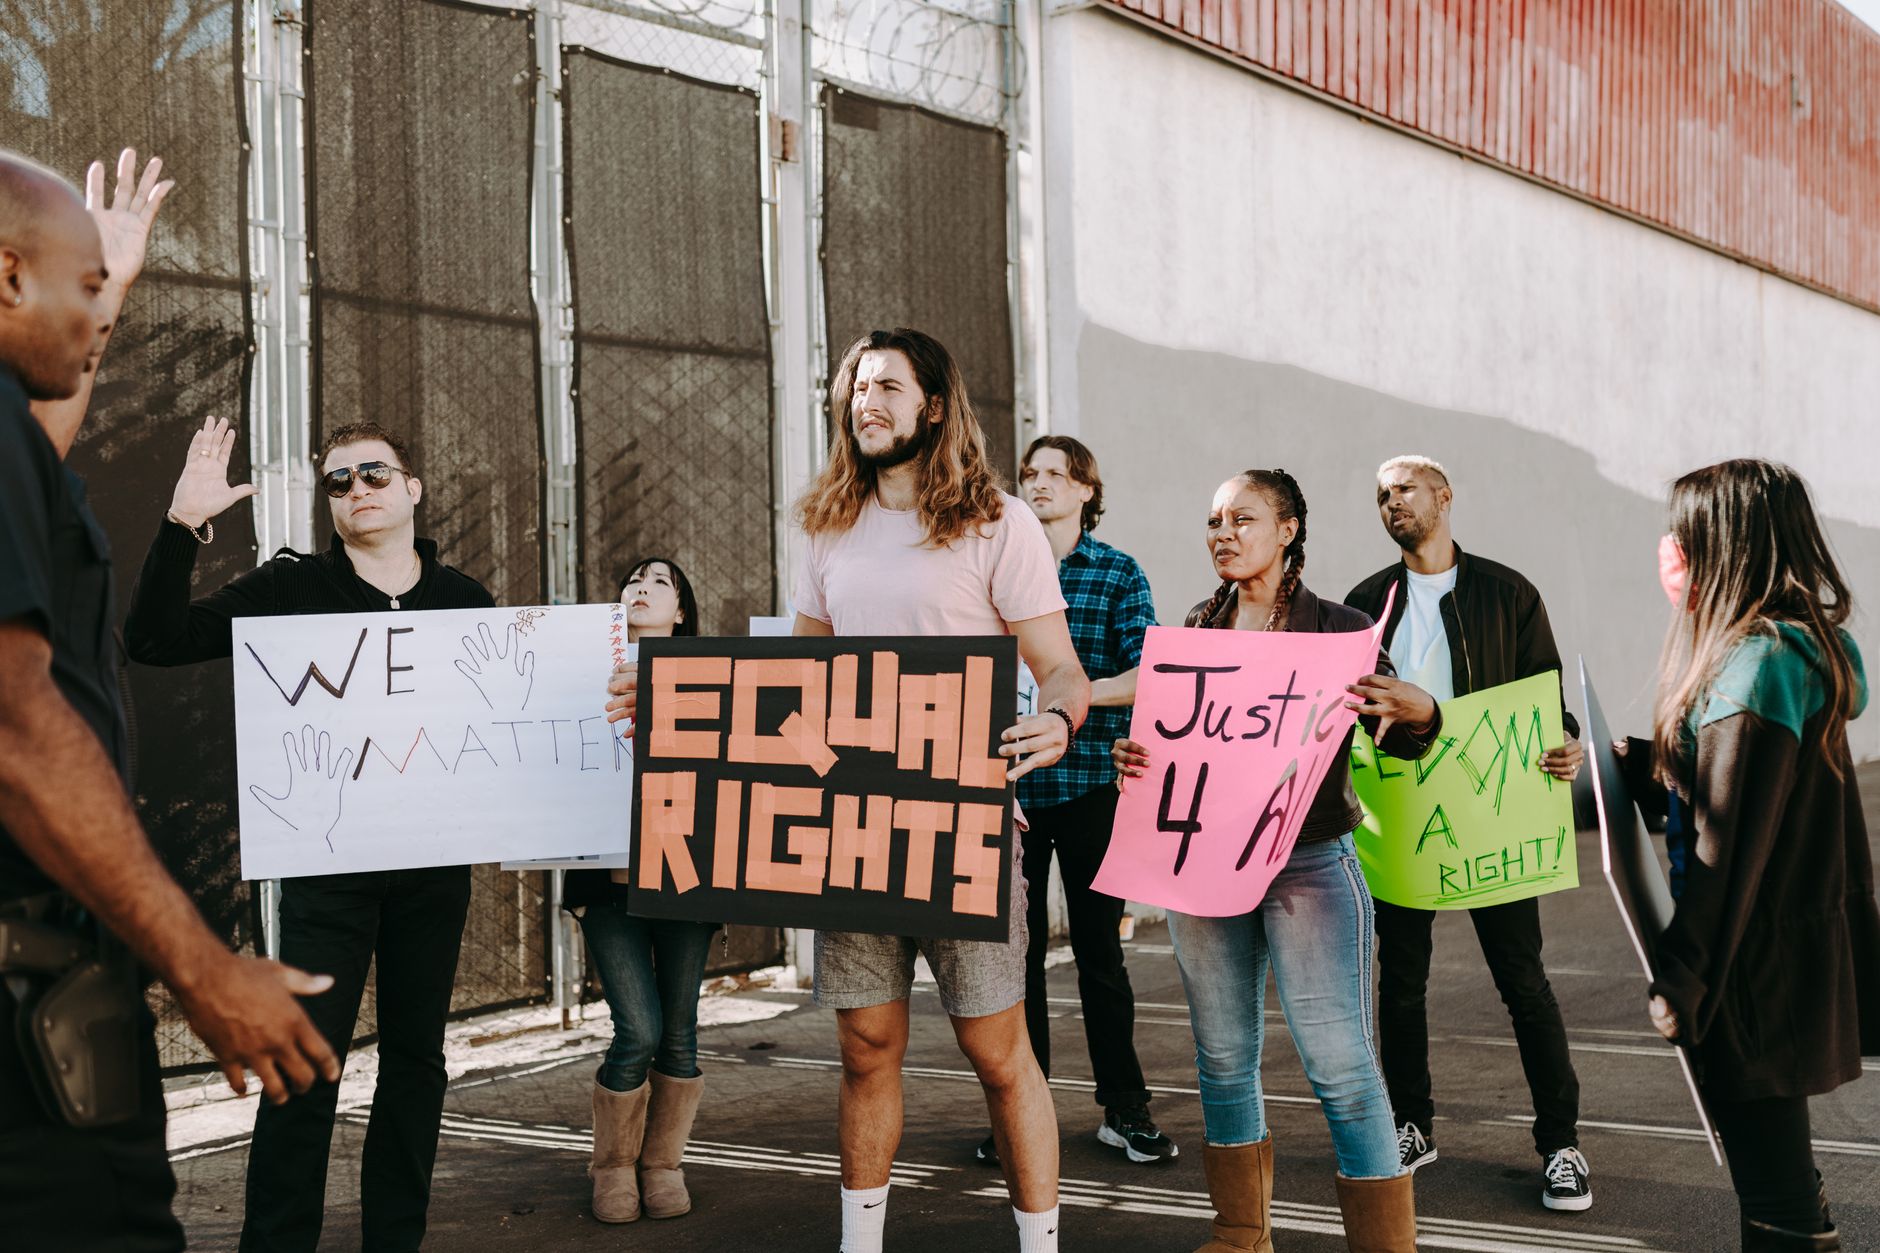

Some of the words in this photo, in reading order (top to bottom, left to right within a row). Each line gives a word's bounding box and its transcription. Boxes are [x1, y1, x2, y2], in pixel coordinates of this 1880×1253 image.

[244, 627, 415, 706] WE
[1153, 664, 1347, 748] Justic
[649, 651, 1009, 789] EQUAL
[638, 771, 1004, 917] RIGHTS
[1156, 761, 1208, 876] 4
[1415, 803, 1459, 855] A
[1439, 825, 1566, 895] RIGHT!
